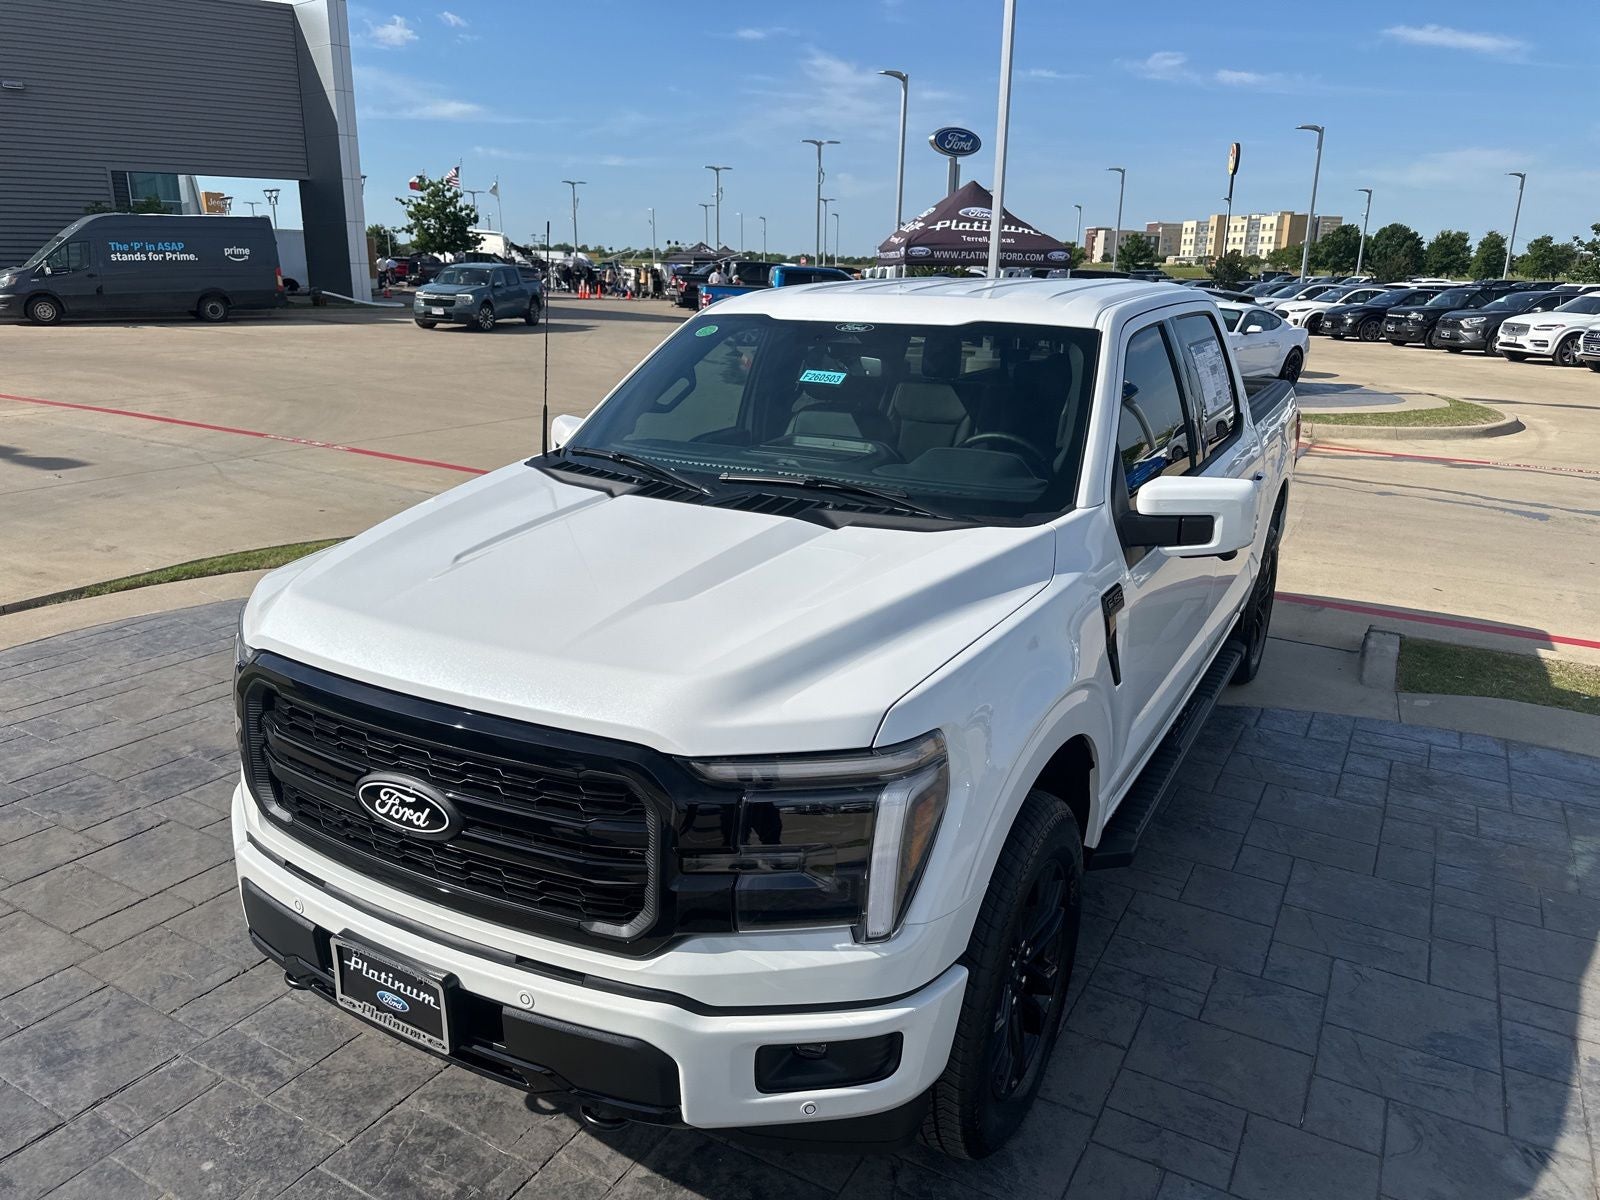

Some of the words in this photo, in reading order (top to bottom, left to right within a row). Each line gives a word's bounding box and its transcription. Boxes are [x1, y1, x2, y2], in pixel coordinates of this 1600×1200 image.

[944, 132, 973, 151] Ford
[928, 219, 1042, 236] Platium
[108, 242, 129, 251] The
[145, 242, 156, 251] in
[157, 242, 185, 251] ASAP
[224, 246, 250, 256] prime
[110, 252, 147, 261] stands
[148, 251, 164, 261] for
[165, 251, 199, 261] Prime.
[933, 249, 1045, 262] WWW.PLATINFORD.COM
[841, 323, 868, 331] Ford
[802, 373, 841, 383] F260503
[375, 788, 430, 828] Ford
[344, 956, 441, 1010] Platinum
[382, 993, 404, 1010] Ford
[361, 1002, 423, 1038] Platinum
